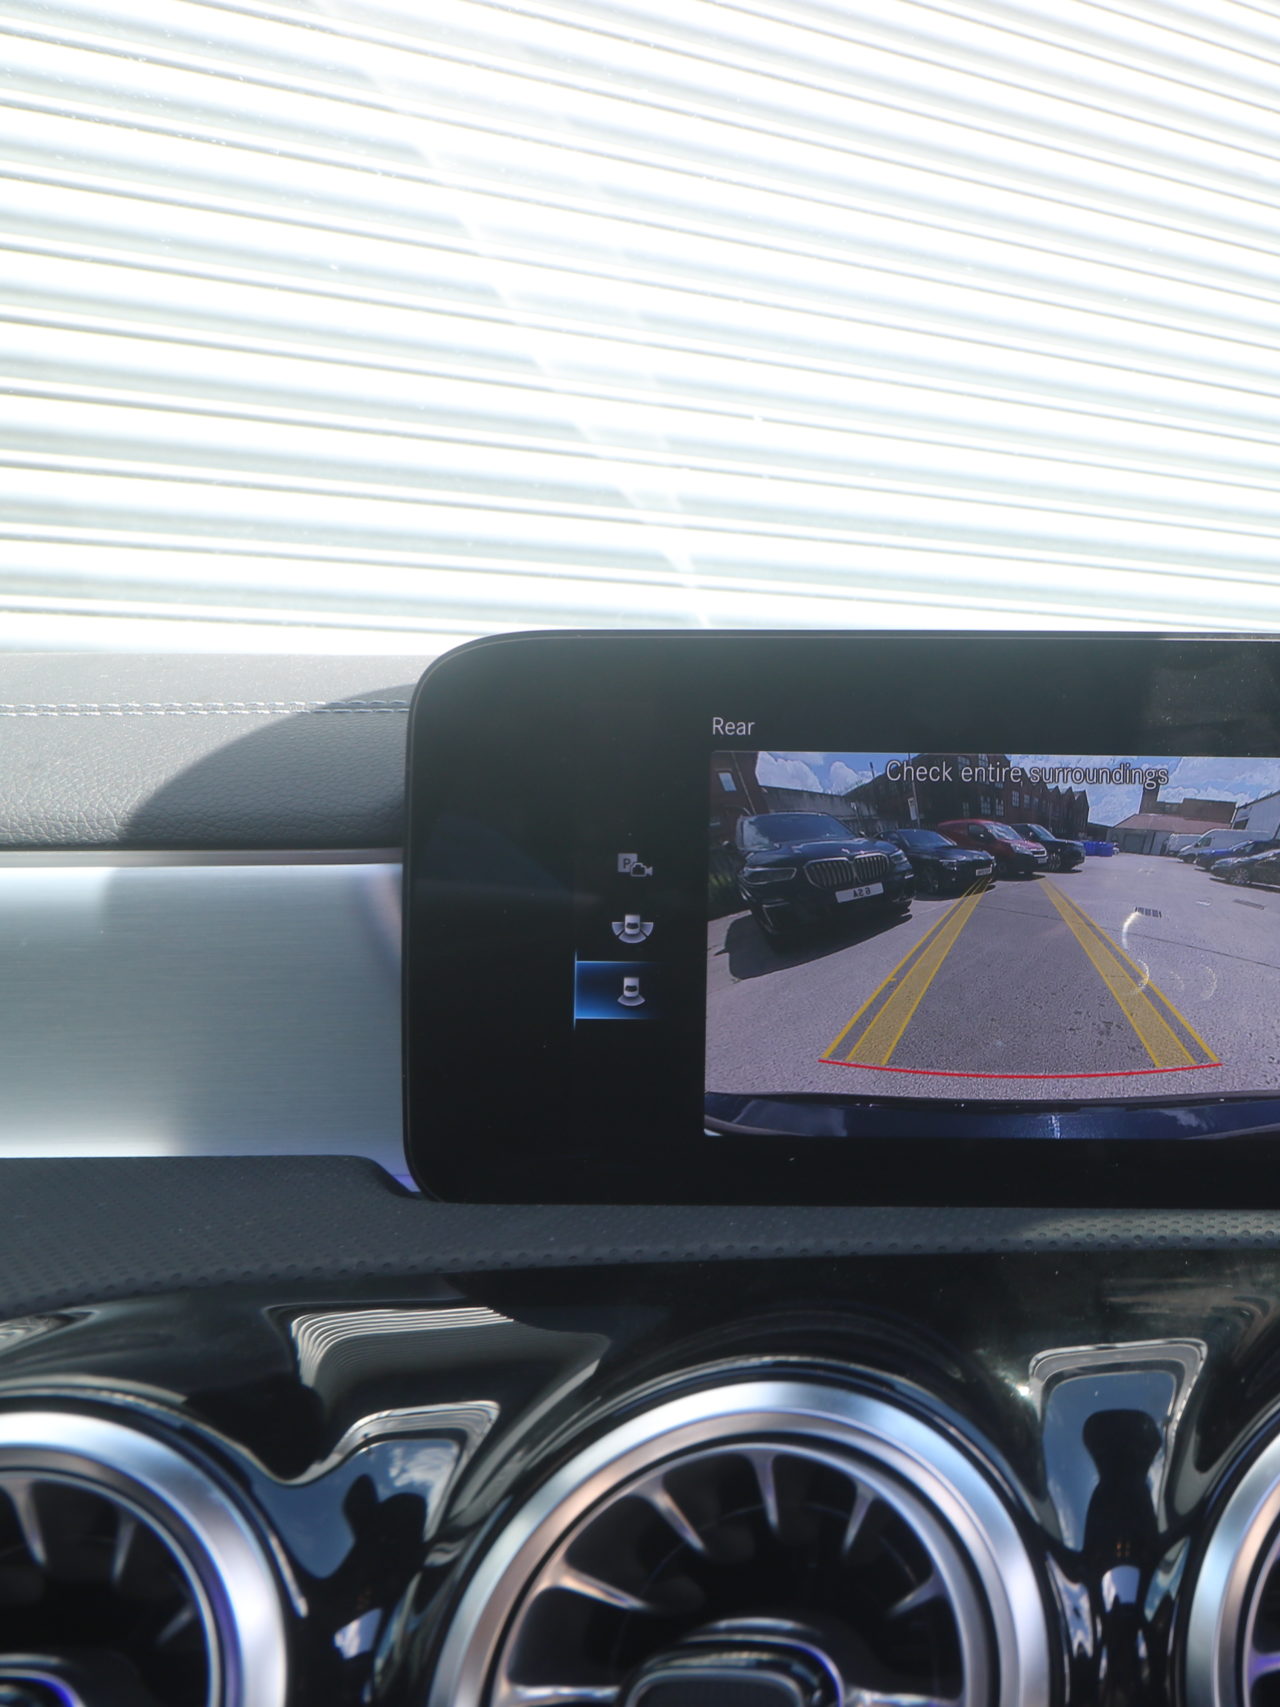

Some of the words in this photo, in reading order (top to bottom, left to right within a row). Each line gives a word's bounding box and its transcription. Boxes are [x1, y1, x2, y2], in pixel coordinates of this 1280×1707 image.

[712, 716, 755, 735] Rear
[886, 760, 953, 782] Check
[960, 761, 1022, 783] entire
[1029, 763, 1170, 790] surroundings
